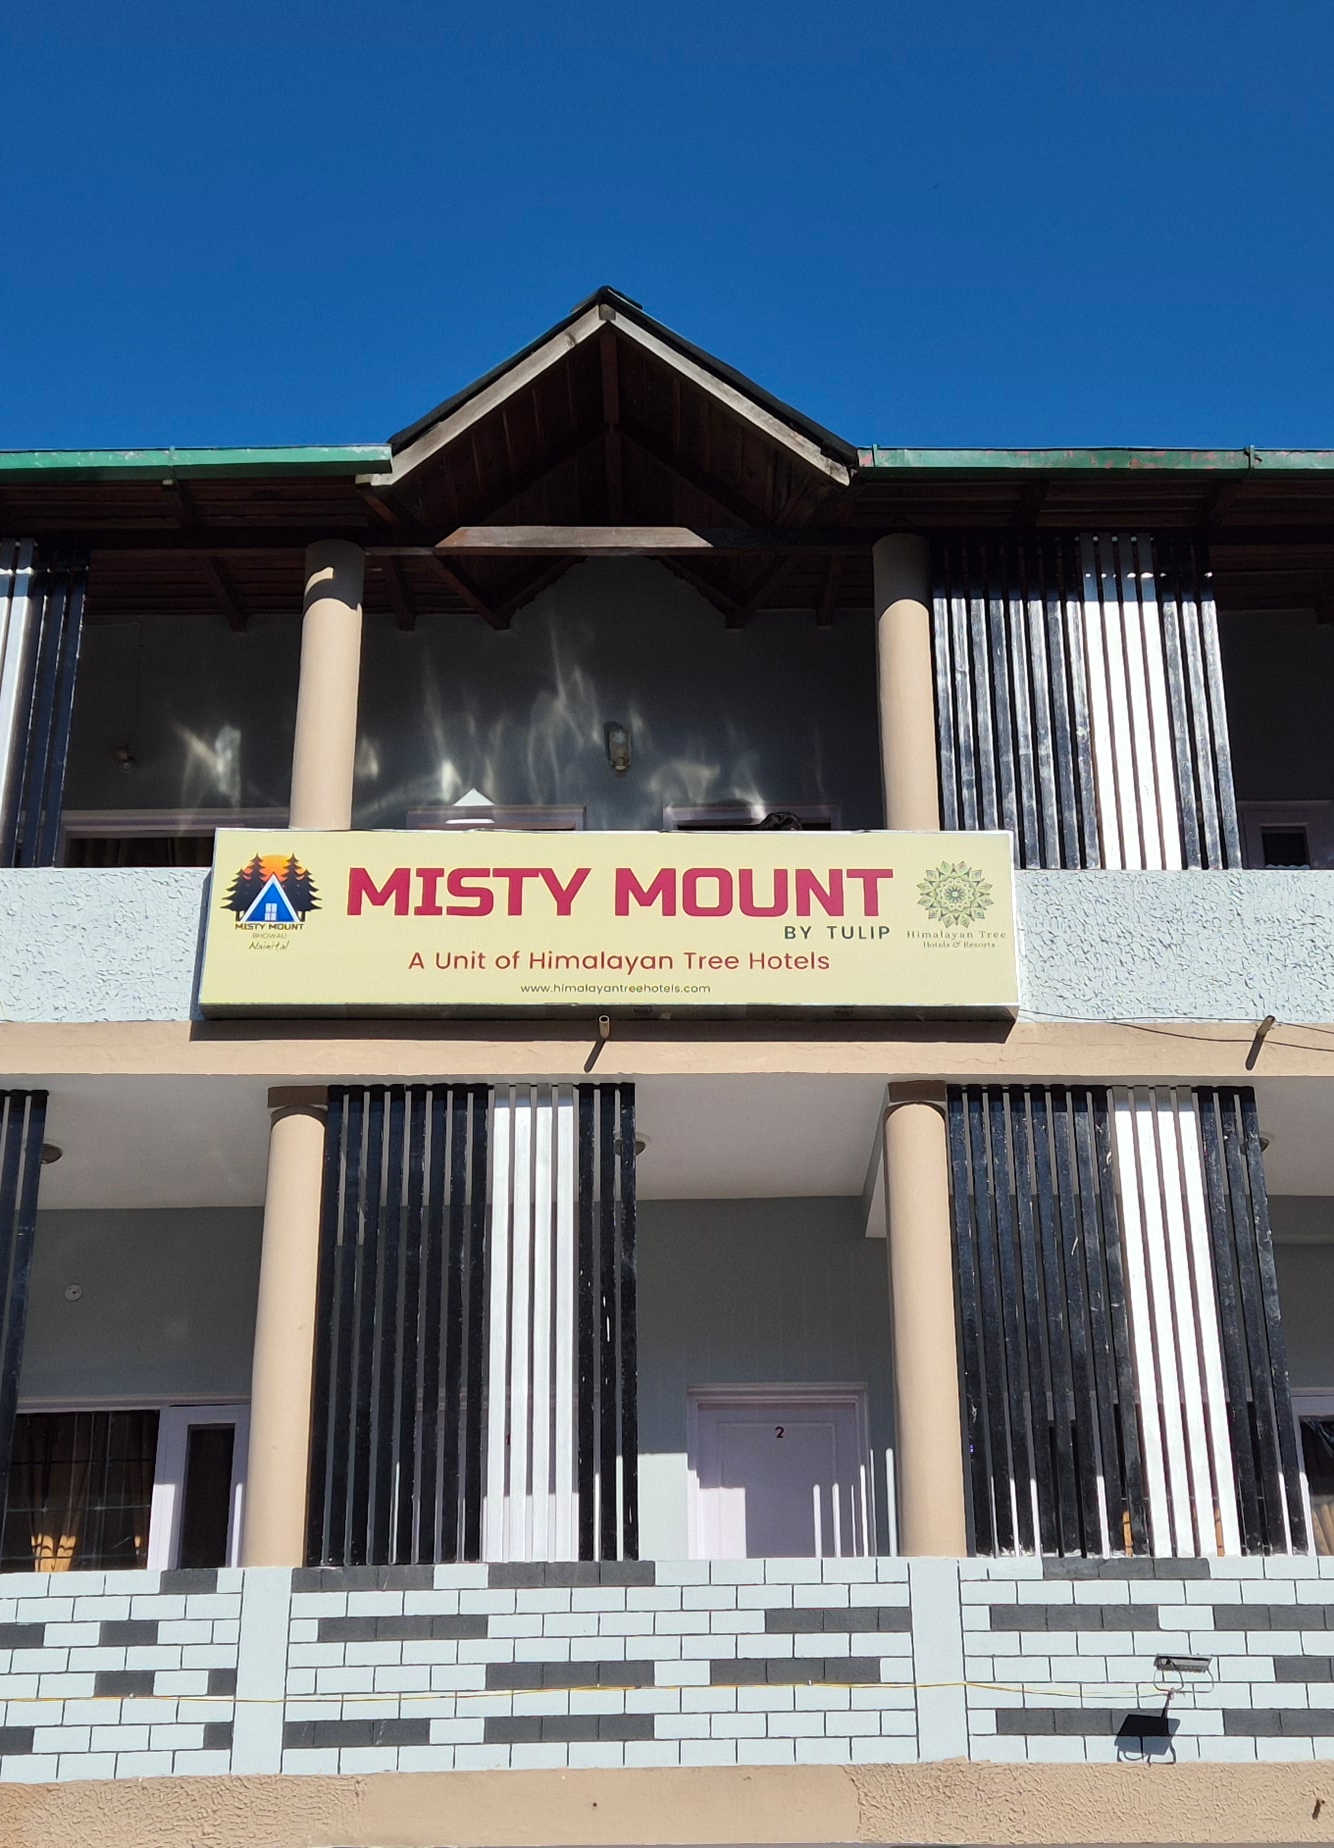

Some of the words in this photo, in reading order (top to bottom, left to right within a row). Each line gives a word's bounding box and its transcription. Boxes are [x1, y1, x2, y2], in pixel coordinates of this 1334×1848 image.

[347, 867, 591, 916] MISTY
[614, 868, 894, 917] MOUNT
[235, 923, 266, 931] MISTY
[269, 923, 305, 931] MOUNT
[784, 926, 812, 940] BY
[827, 926, 891, 940] TULIP
[907, 930, 973, 941] Himalayan
[979, 930, 1007, 939] Tree
[248, 940, 290, 951] Nainital
[408, 952, 425, 970] A
[435, 951, 486, 970] Unit
[495, 951, 520, 970] of
[529, 951, 674, 976] Himalayan
[684, 952, 740, 970] Tree
[749, 951, 831, 970] Hotels
[520, 983, 711, 995] www.himalayantreehotels.com
[775, 1426, 784, 1439] 2
